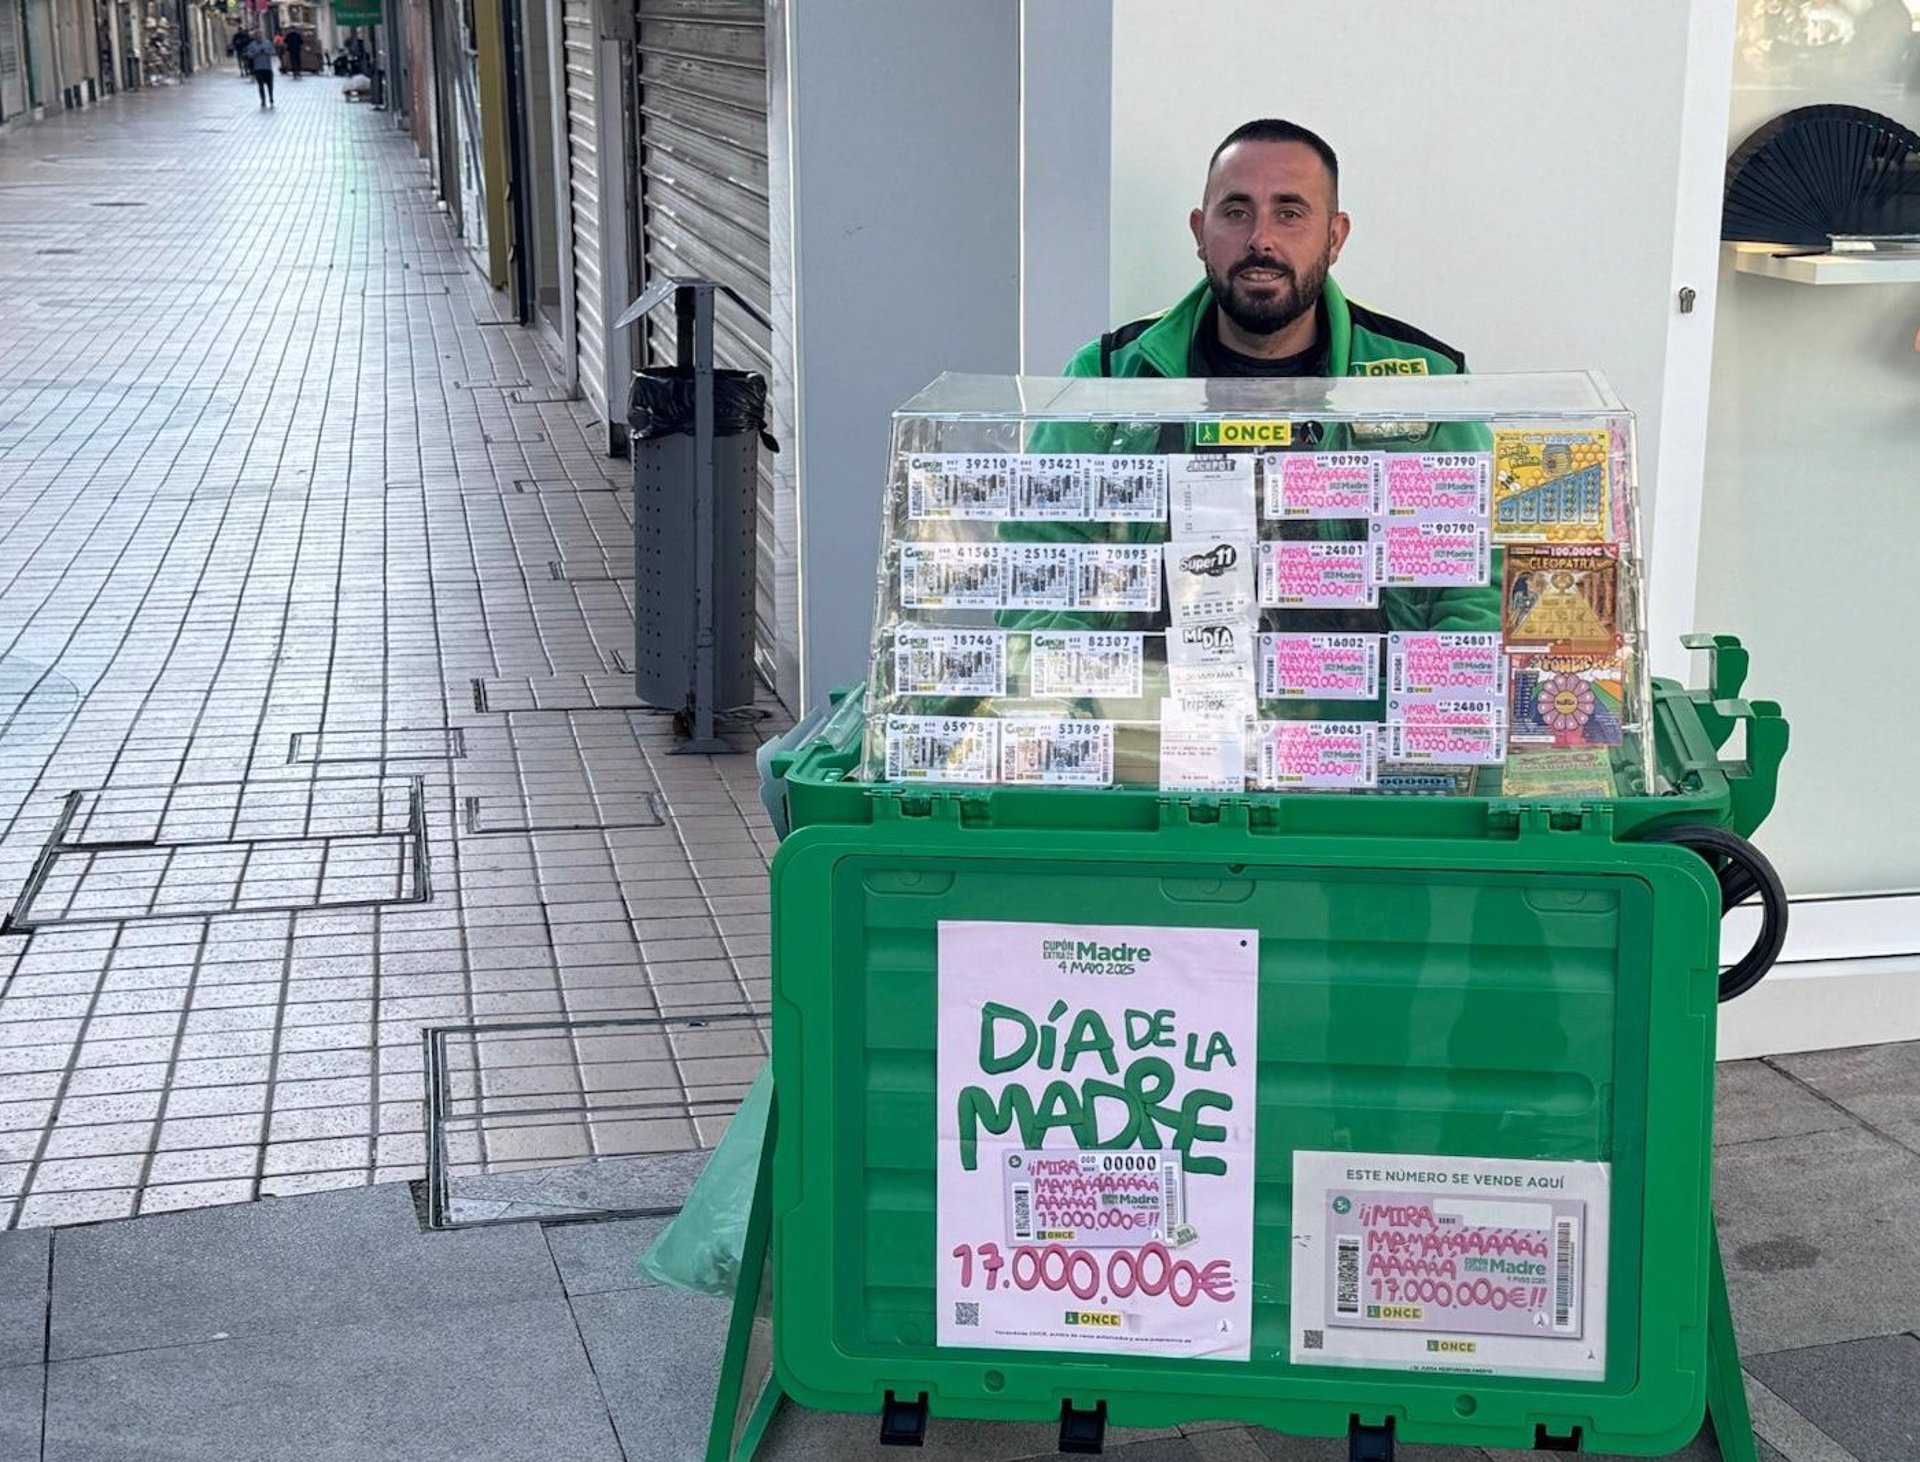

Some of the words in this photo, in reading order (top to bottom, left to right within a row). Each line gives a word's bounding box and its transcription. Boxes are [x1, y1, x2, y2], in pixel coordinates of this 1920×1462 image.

[1370, 362, 1422, 376] ONCE
[1224, 425, 1286, 440] ONCE
[965, 458, 1007, 469] 39210
[1040, 459, 1080, 470] 93421
[1112, 460, 1154, 470] 09152
[1437, 456, 1475, 466] 90790
[1436, 523, 1475, 533] 90790
[1530, 558, 1596, 570] CLEOPATRA
[1060, 724, 1100, 734] 53789
[1043, 938, 1074, 951] CUPÓN
[1077, 941, 1151, 962] Madre
[1058, 961, 1067, 974] 4
[1070, 961, 1104, 975] MAYO
[1106, 962, 1135, 975] 2025
[979, 1000, 1119, 1075] DÍA
[1124, 1008, 1176, 1050] DE
[1184, 1031, 1236, 1071] LA
[958, 1056, 1233, 1175] MADRE
[1103, 1156, 1156, 1171] 00000
[1347, 1169, 1381, 1181] ESTE
[1386, 1168, 1447, 1183] NÚMERO
[1452, 1174, 1469, 1185] SE
[1474, 1174, 1522, 1187] VENDE
[1527, 1175, 1565, 1189] AQUÍ
[1120, 1194, 1159, 1204] Madre
[1047, 1231, 1074, 1239] ONCE
[1489, 1258, 1547, 1276] Madre
[953, 1241, 1235, 1307] 17.000.000€
[1383, 1308, 1421, 1318] ONCE
[1081, 1314, 1119, 1325] ONCE
[1441, 1341, 1475, 1352] ONCE
